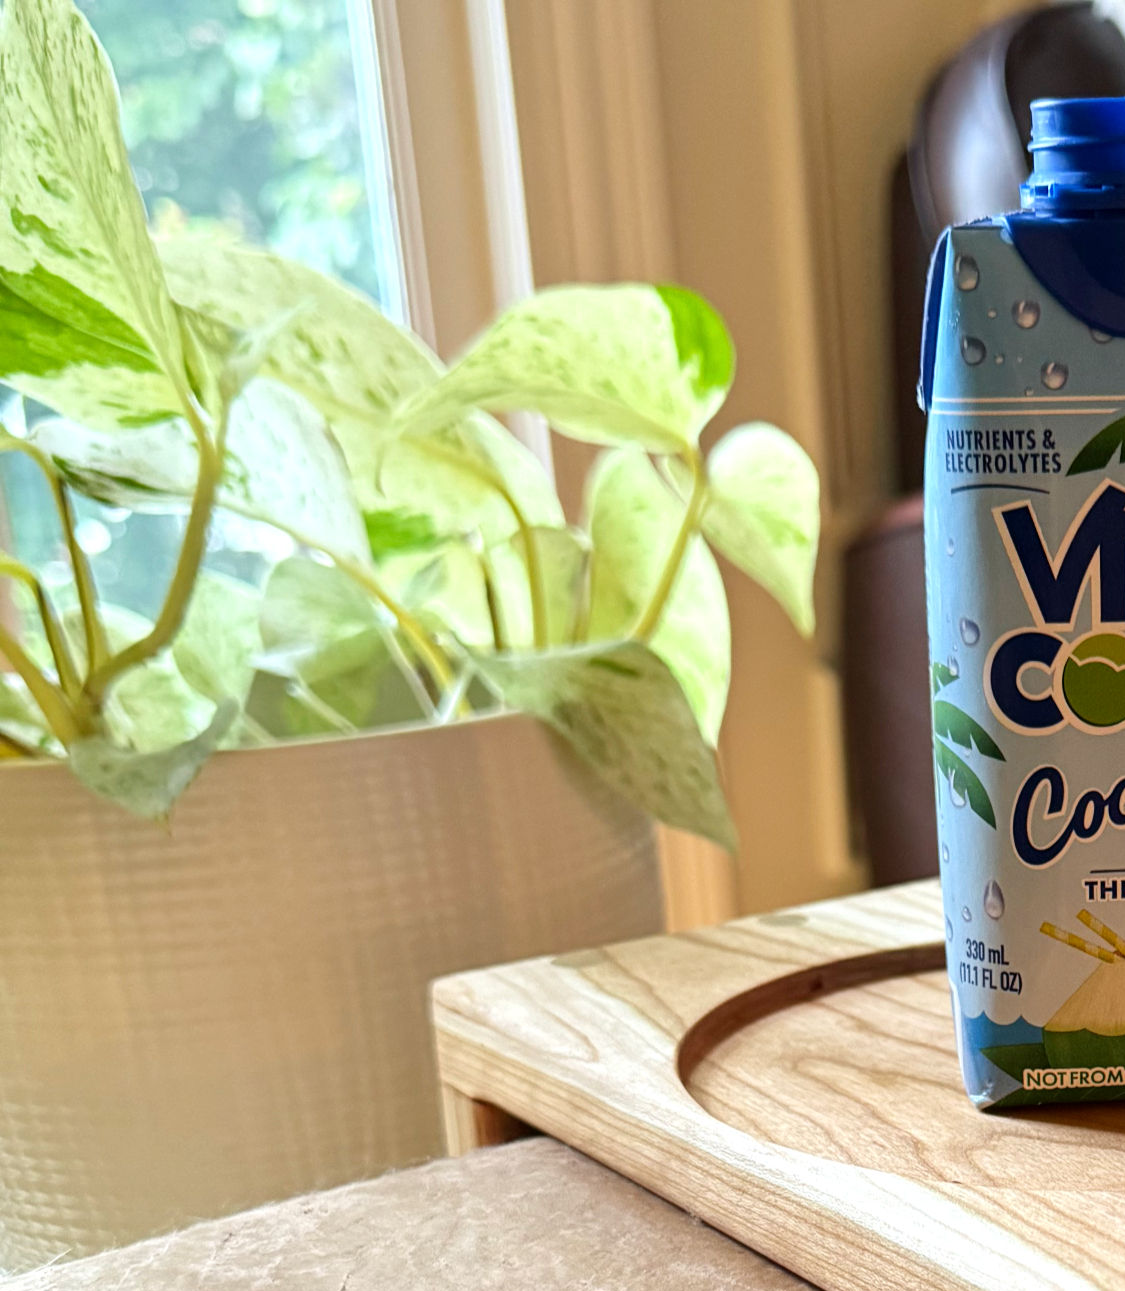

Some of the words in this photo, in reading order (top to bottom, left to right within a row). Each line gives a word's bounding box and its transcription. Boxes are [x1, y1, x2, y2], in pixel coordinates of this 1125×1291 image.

[947, 429, 1036, 451] NUTRIENTS
[1042, 429, 1056, 450] &
[945, 453, 1062, 474] ELECTROLYTES
[965, 938, 985, 961] 330
[988, 945, 1010, 966] mL
[959, 962, 978, 985] (11.1
[982, 968, 997, 989] FL
[1000, 971, 1023, 995] OZ)
[1026, 1069, 1068, 1088] NOT
[1069, 1067, 1124, 1086] FROM
